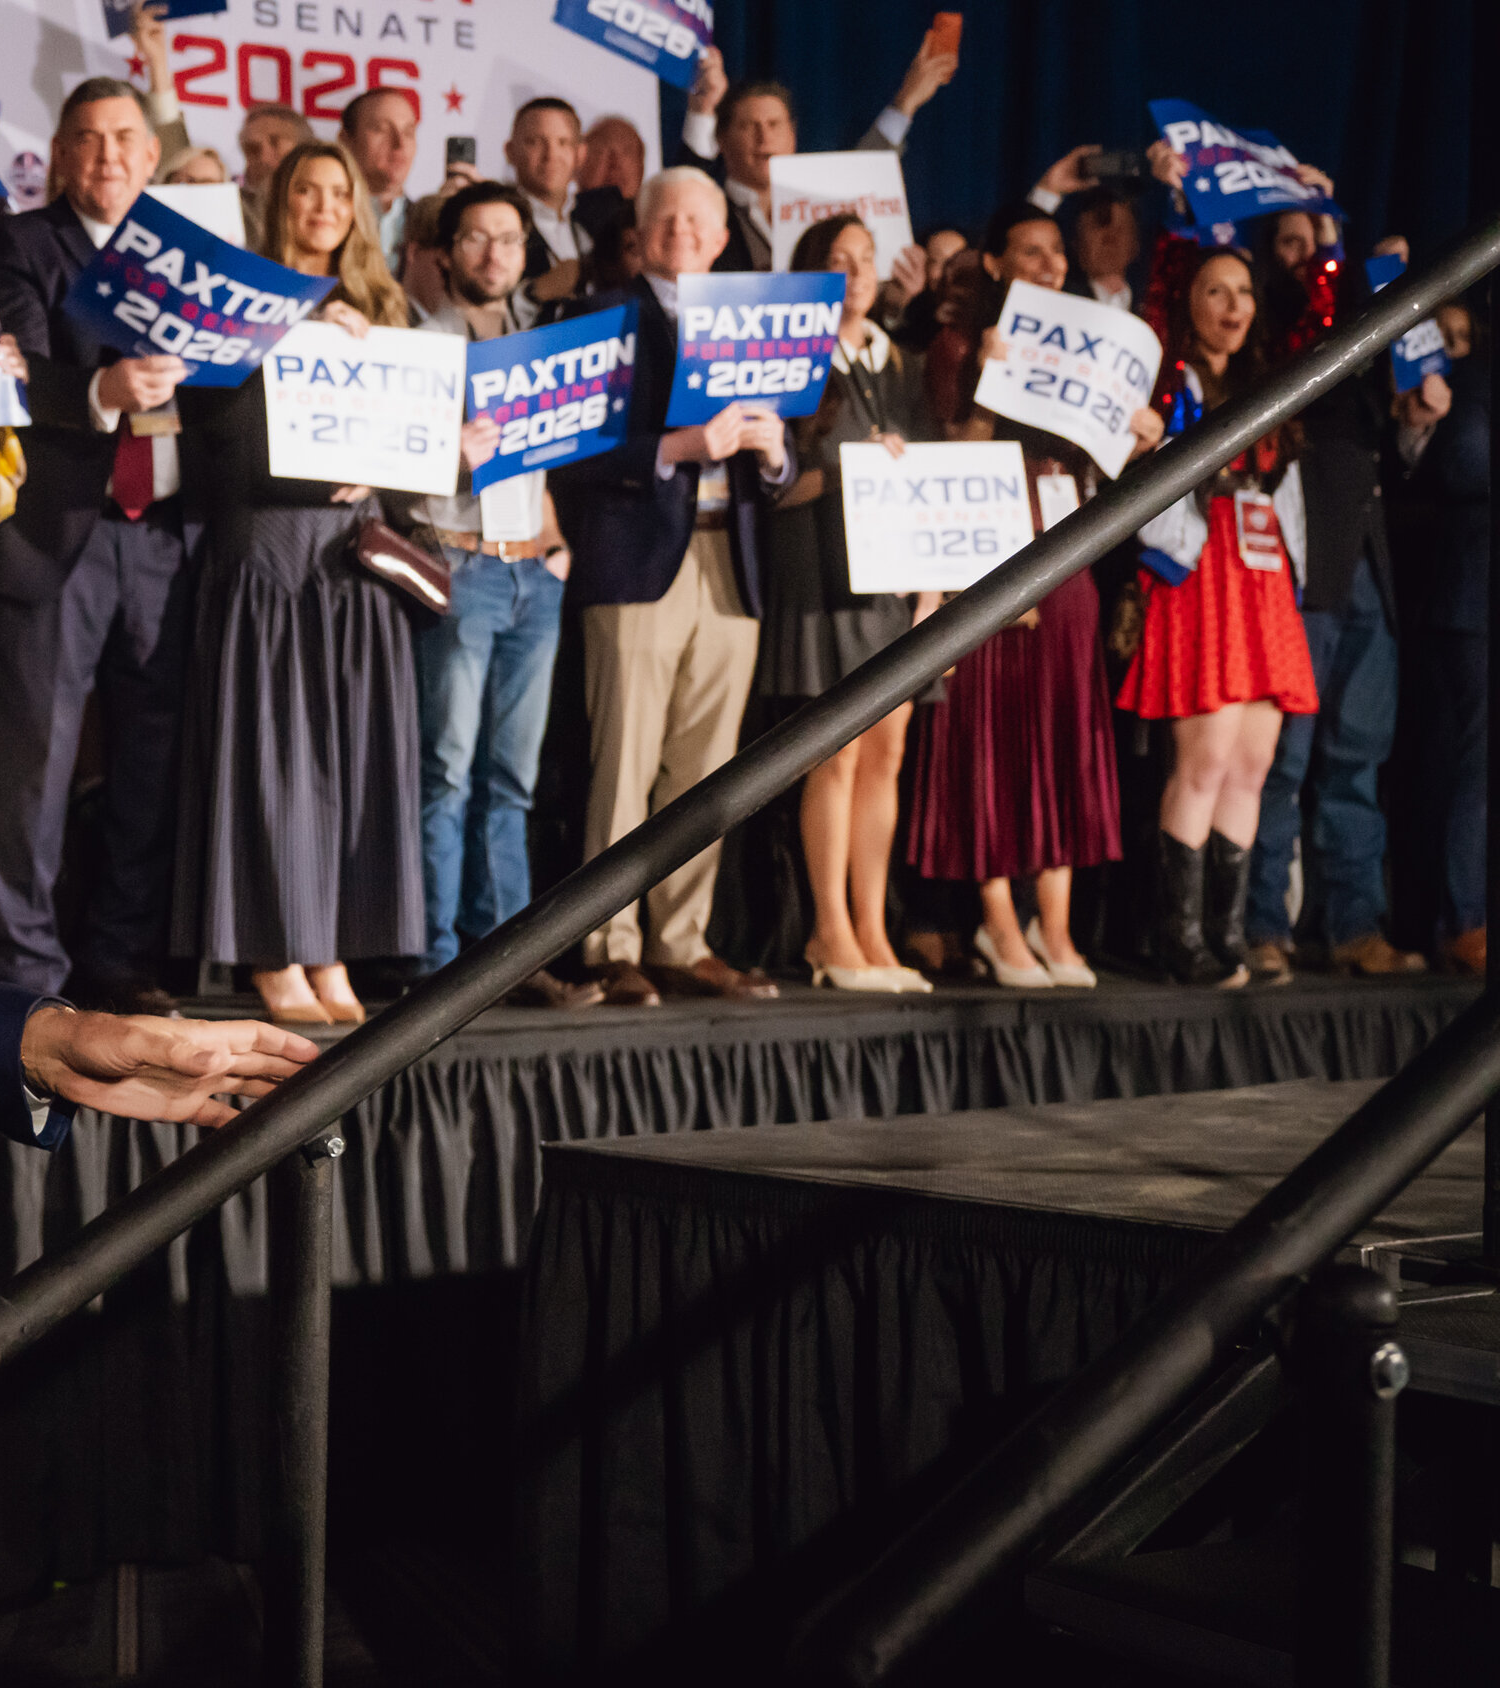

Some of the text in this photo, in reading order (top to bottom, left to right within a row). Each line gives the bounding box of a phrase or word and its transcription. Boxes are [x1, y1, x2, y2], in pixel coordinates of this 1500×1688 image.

[253, 0, 476, 50] SENATE
[113, 219, 316, 326] PAXTON
[113, 290, 253, 366] 2026
[682, 301, 844, 341] PAXTON
[275, 355, 458, 401] PAXTON
[470, 332, 636, 409] PAXTON
[706, 357, 813, 397] 2026
[499, 392, 609, 456] 2026
[1023, 368, 1126, 435] 2026
[852, 473, 1021, 506] PAXTON
